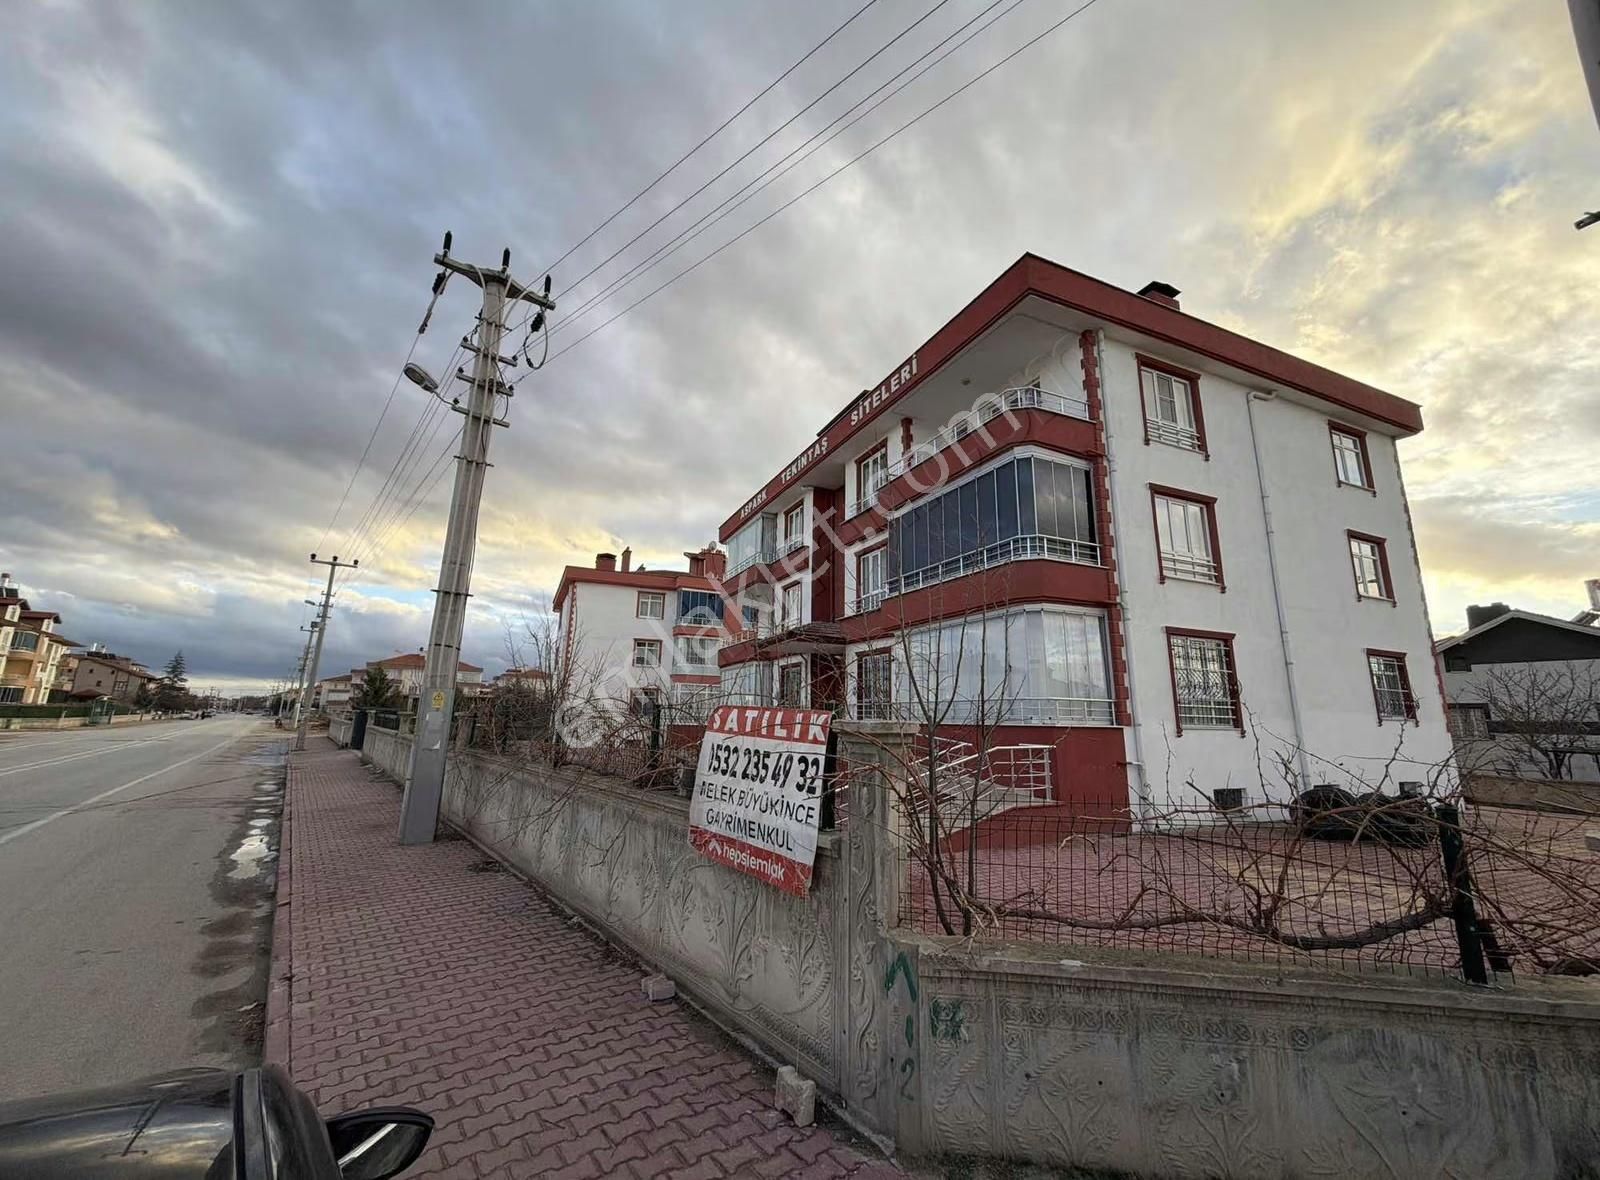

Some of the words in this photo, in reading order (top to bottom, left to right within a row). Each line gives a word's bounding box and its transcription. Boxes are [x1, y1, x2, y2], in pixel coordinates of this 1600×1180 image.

[781, 437, 828, 484] TEKİNTAŞ
[850, 354, 918, 426] SİTELERİ
[713, 708, 829, 741] SATILIK
[741, 748, 771, 784] 235
[771, 753, 794, 788] 49
[795, 755, 821, 795] 32
[706, 808, 793, 852] GAYRİMENKUL
[722, 842, 785, 881] hepsiemlak
